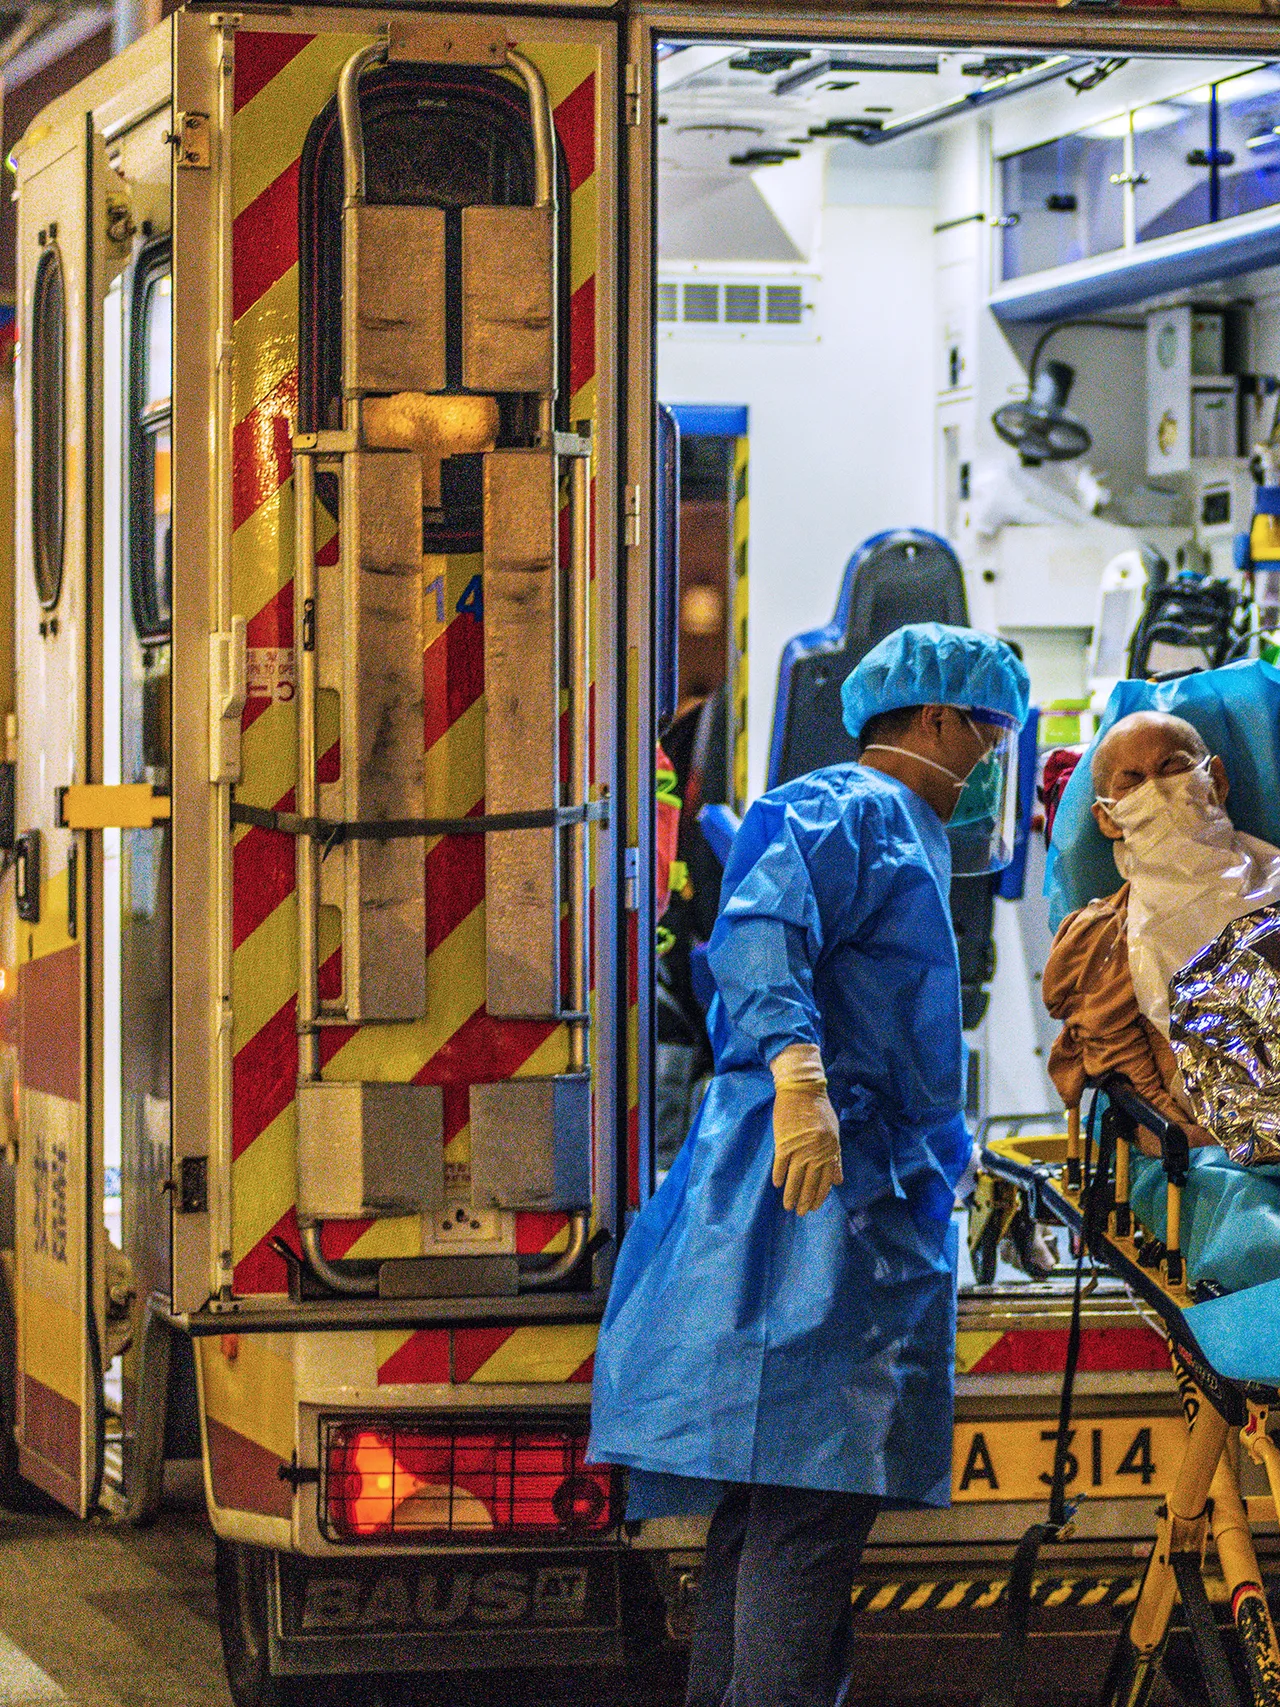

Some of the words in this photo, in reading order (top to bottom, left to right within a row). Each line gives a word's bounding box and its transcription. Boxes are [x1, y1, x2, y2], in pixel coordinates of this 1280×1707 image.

[424, 574, 484, 623] 14
[959, 1432, 1000, 1490] A
[1038, 1426, 1158, 1488] 314
[302, 1570, 530, 1629] BAUS
